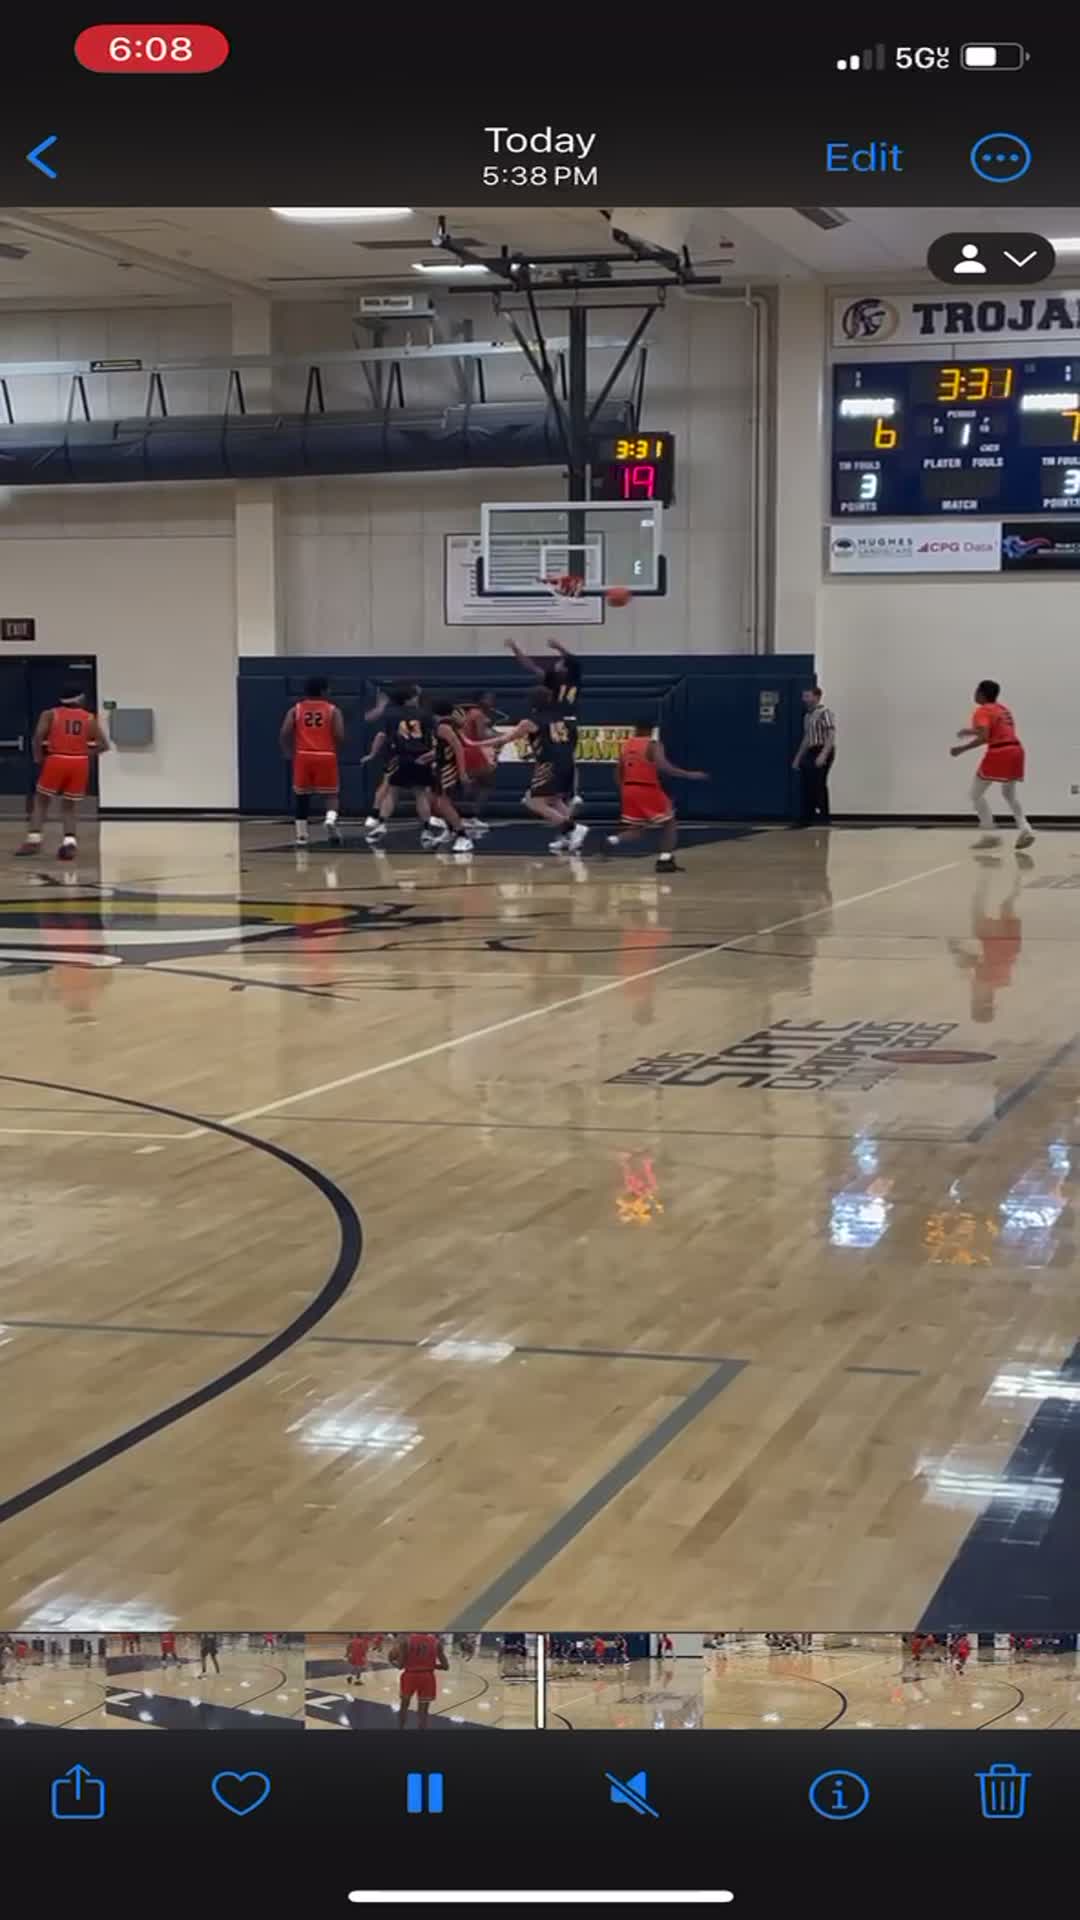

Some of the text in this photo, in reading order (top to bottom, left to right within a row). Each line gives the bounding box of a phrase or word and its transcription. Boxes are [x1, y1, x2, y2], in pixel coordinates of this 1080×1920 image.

[912, 299, 1080, 335] TROJA
[938, 367, 1012, 401] 3:31
[875, 417, 896, 448] 6
[962, 423, 971, 446] 1
[1061, 410, 1080, 442] 7
[615, 440, 663, 460] 3:31
[923, 458, 962, 468] PLAYER
[624, 466, 655, 499] 19
[860, 473, 878, 499] 3
[1063, 469, 1080, 494] 3
[941, 500, 978, 510] MATCH
[858, 537, 912, 546] HUGHES
[930, 542, 960, 553] CPG
[64, 719, 82, 736] 10
[304, 711, 323, 728] 22
[658, 1020, 862, 1088] STATE
